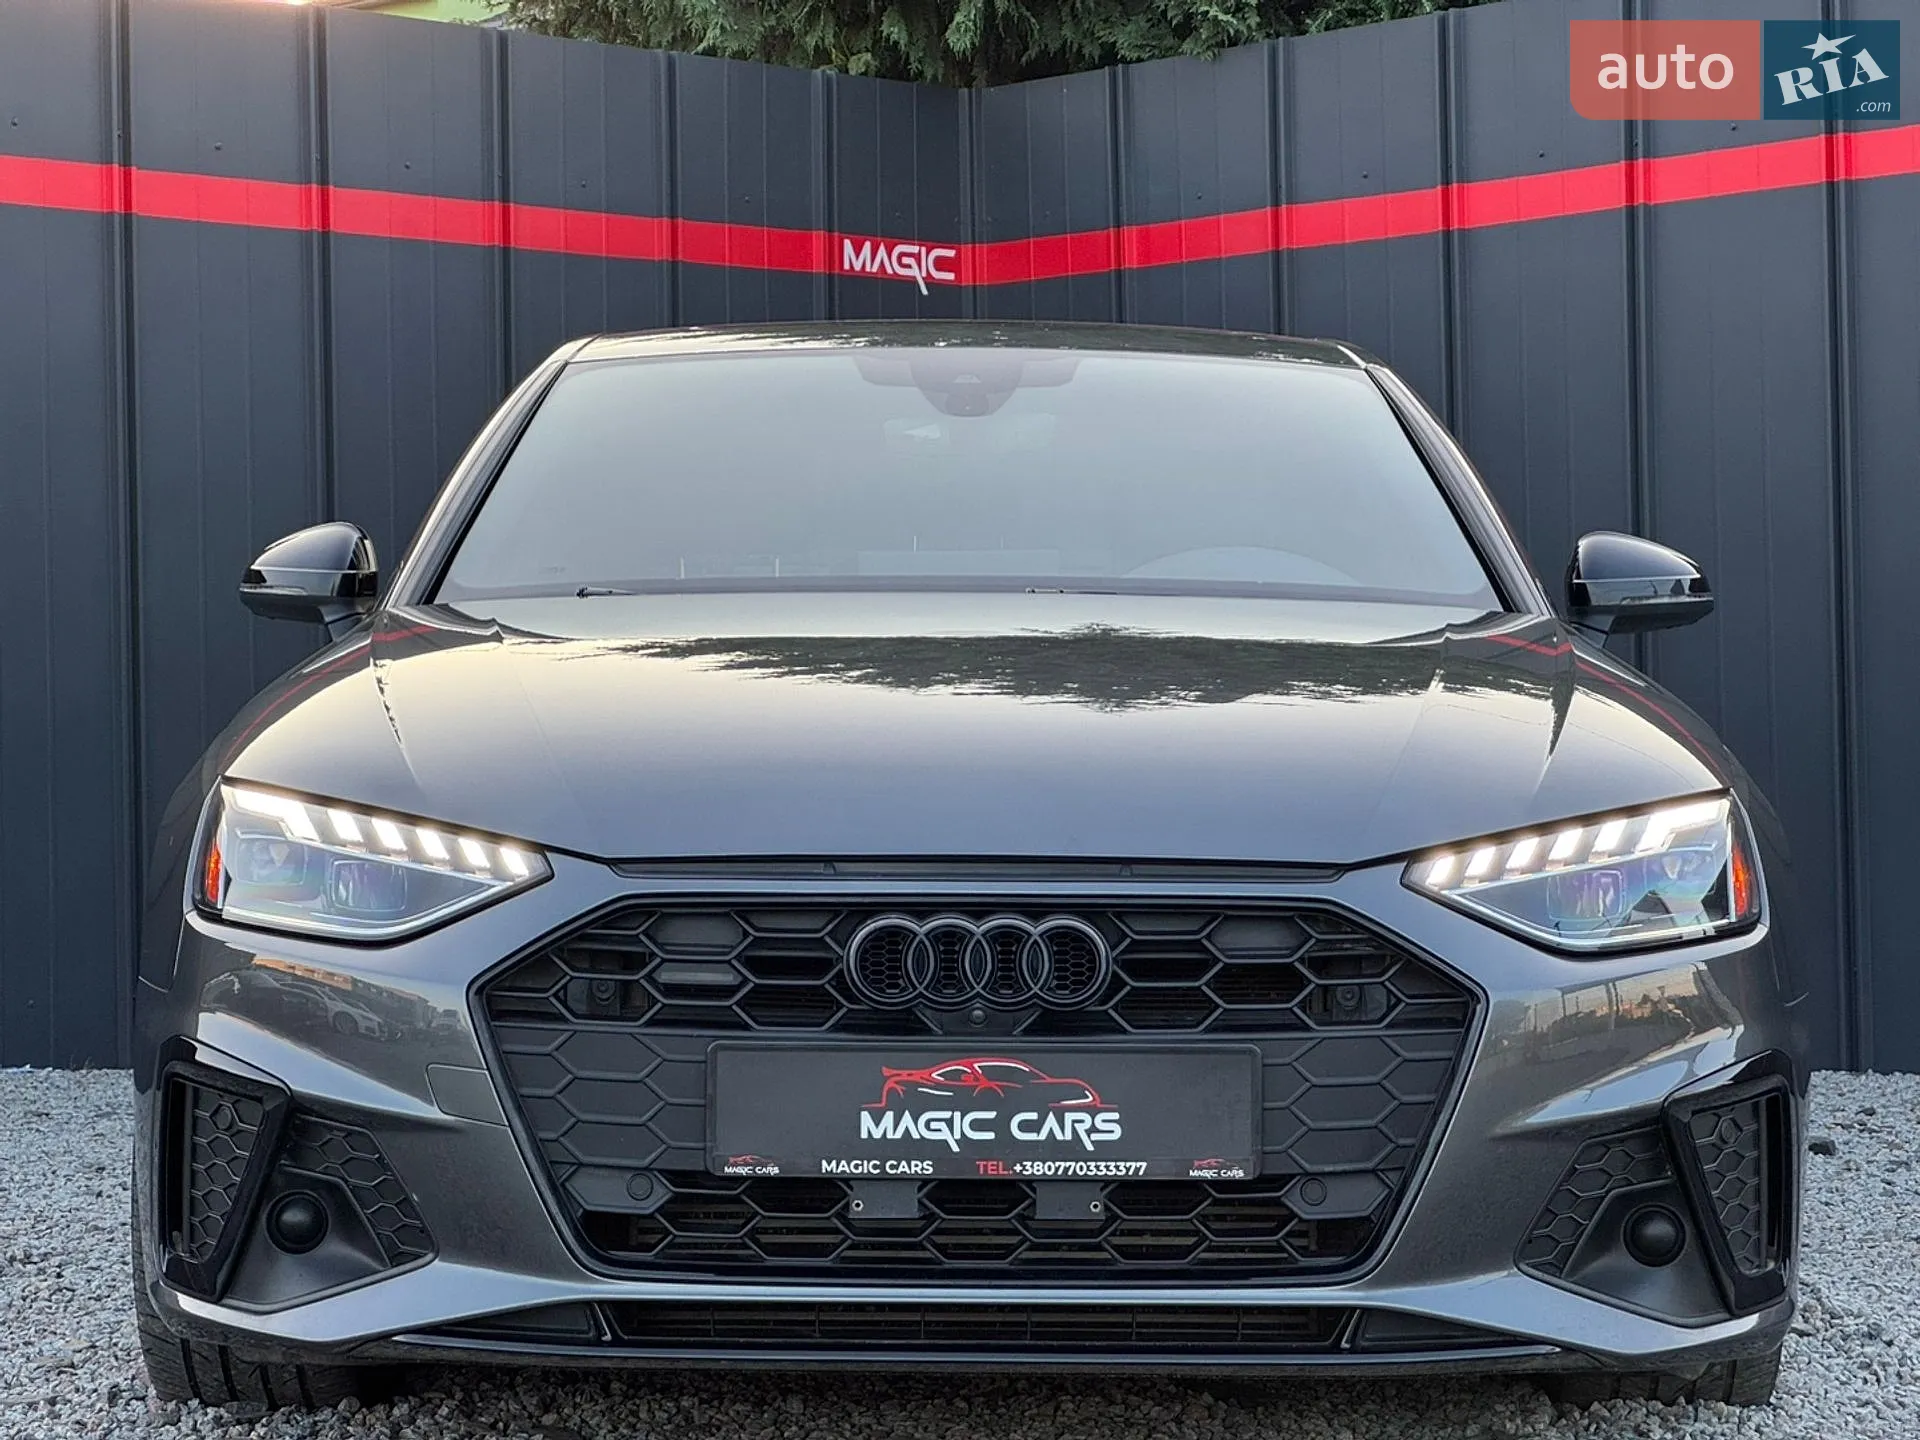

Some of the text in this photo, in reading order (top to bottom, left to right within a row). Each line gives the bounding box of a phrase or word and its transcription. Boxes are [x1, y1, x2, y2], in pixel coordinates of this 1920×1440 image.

[843, 238, 956, 295] MAGIC
[860, 1109, 1122, 1152] MAGIC CARS
[723, 1166, 780, 1176] MAGIC CARS
[821, 1159, 934, 1175] MAGIC CARS
[1189, 1169, 1245, 1179] MAGIC CARS
